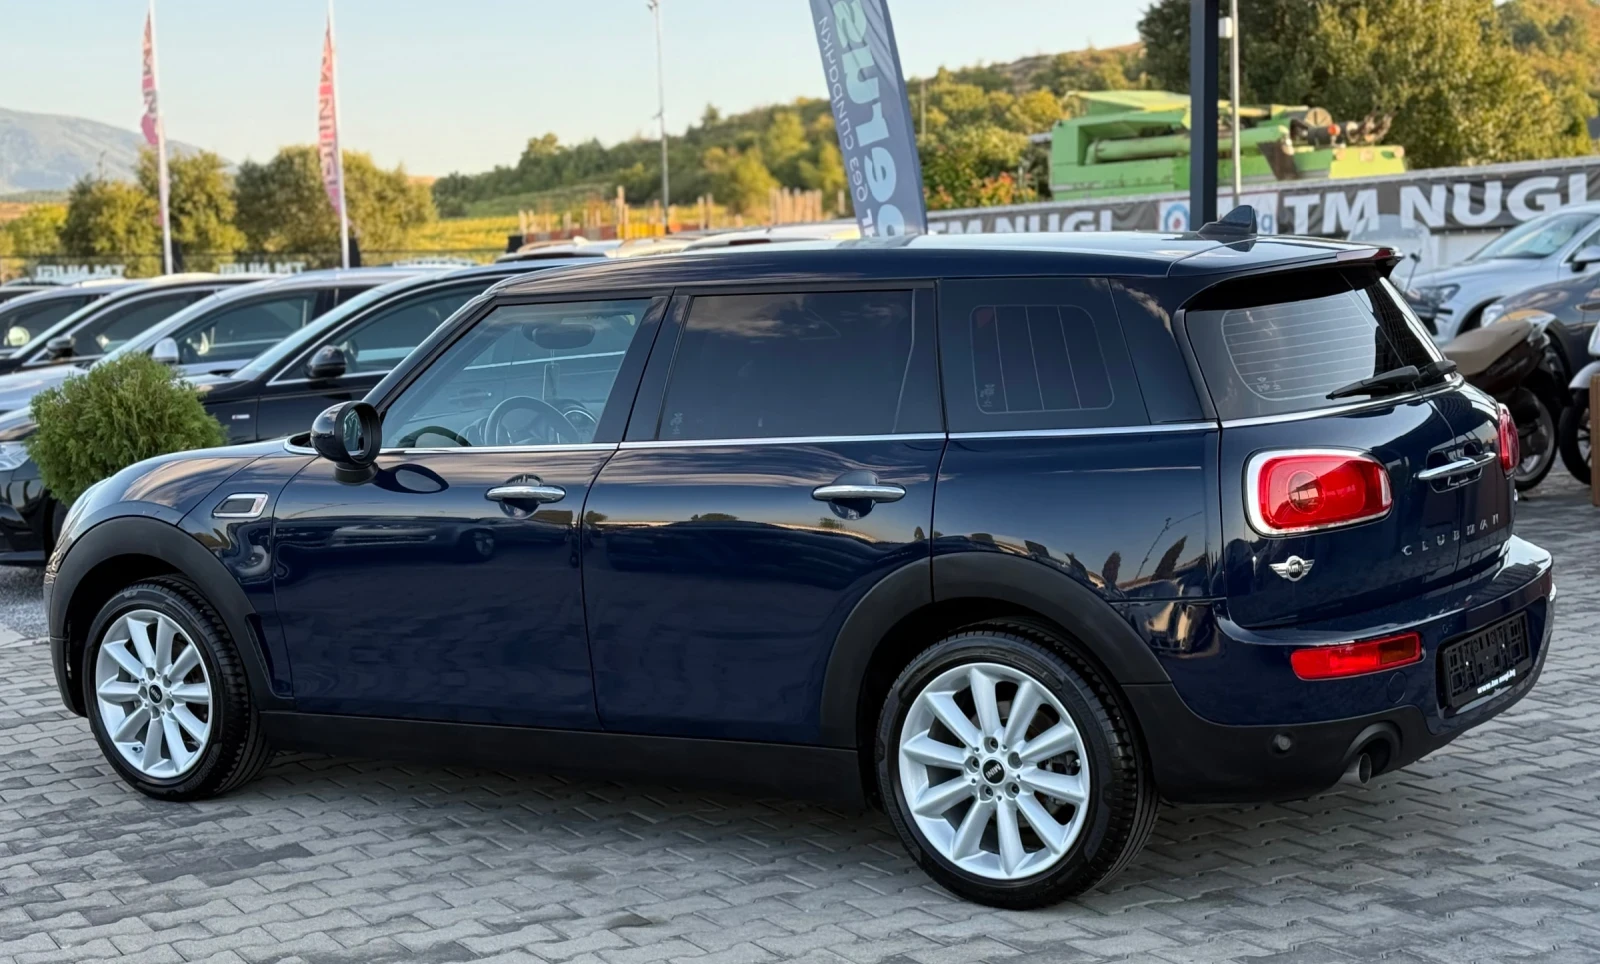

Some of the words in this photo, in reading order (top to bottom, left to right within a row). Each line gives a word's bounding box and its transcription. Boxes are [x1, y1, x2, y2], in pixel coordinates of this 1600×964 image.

[1284, 188, 1379, 235] TM
[1400, 173, 1588, 229] NUGI
[1401, 513, 1500, 557] CLUBMAN
[985, 763, 1002, 778] MINI
